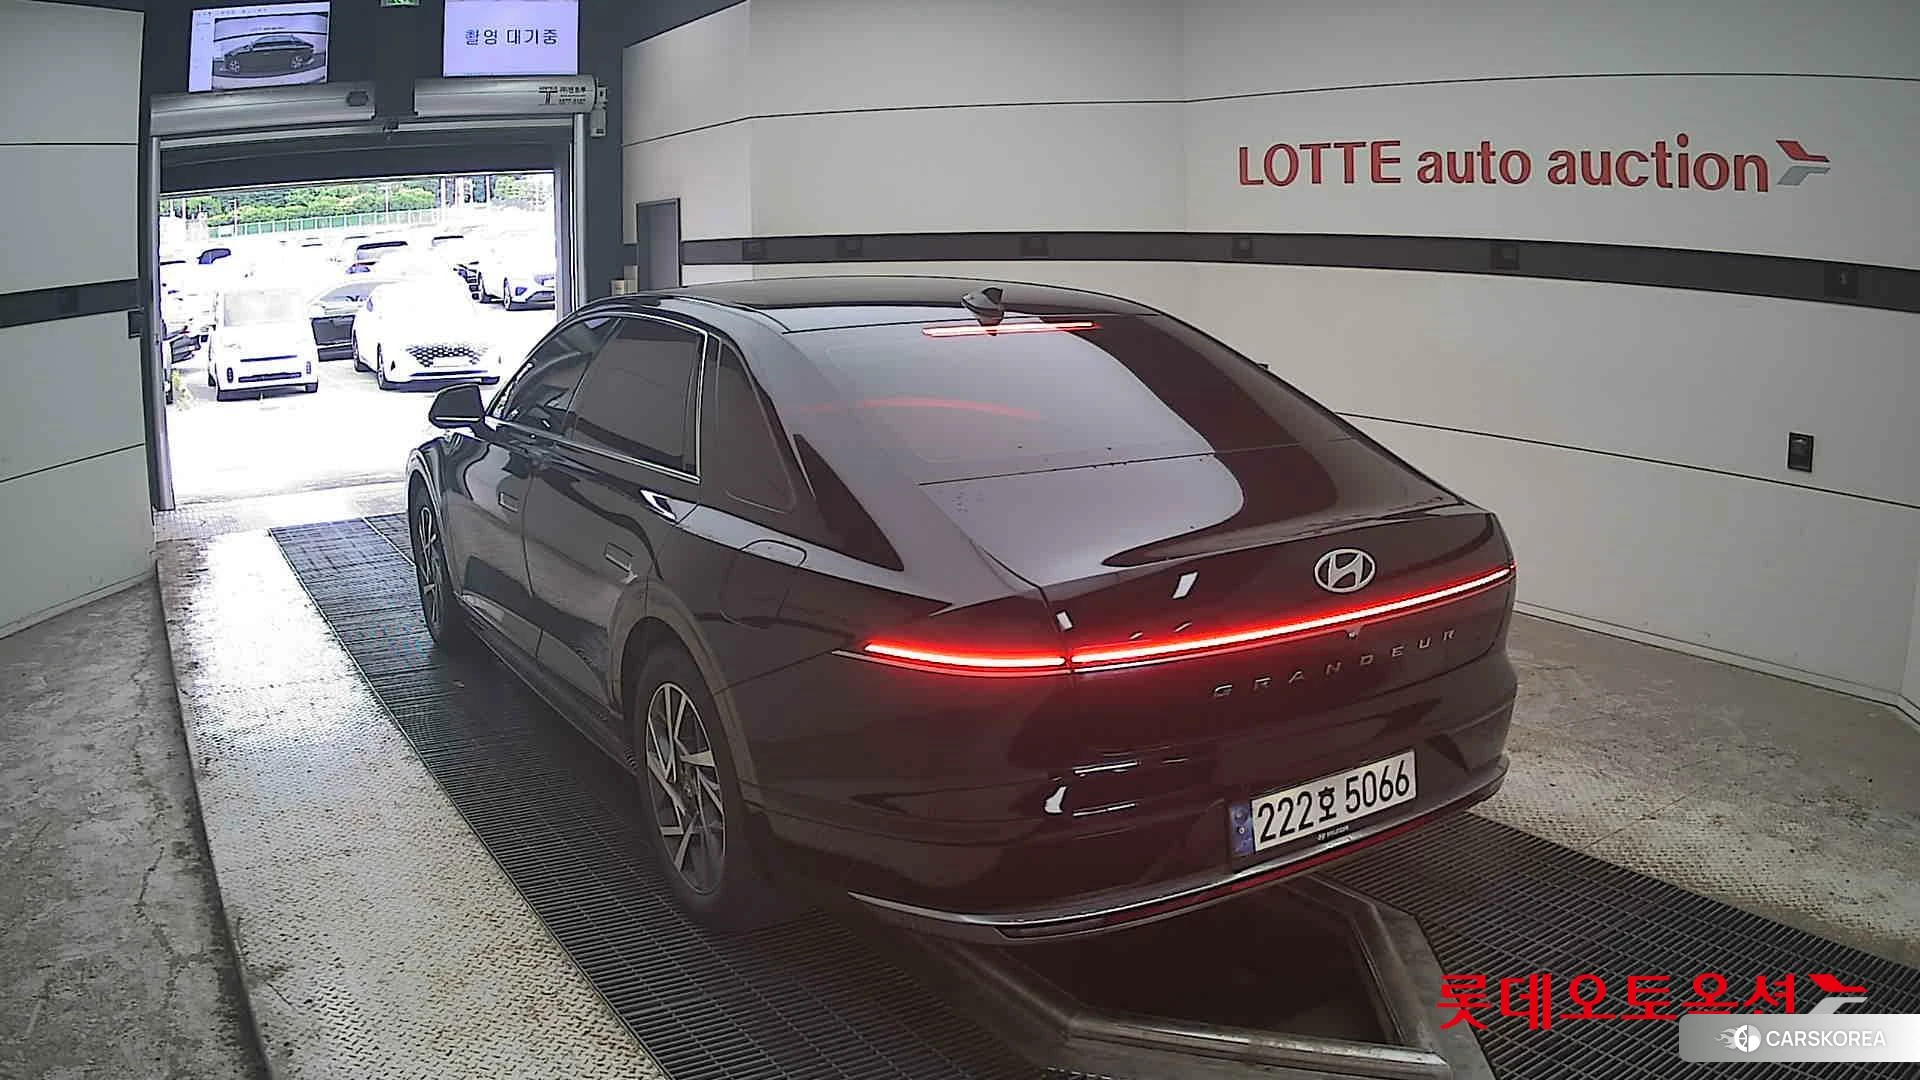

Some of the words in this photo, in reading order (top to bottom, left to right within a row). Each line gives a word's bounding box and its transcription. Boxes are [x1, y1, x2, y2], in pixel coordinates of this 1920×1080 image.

[506, 28, 558, 46] 대기중
[1239, 140, 1401, 187] LOTTE
[1417, 141, 1532, 185] auto
[1548, 133, 1769, 192] auction
[1213, 628, 1456, 697] GRANDEUR
[1257, 786, 1337, 843] 222호
[1345, 760, 1410, 814] 5066
